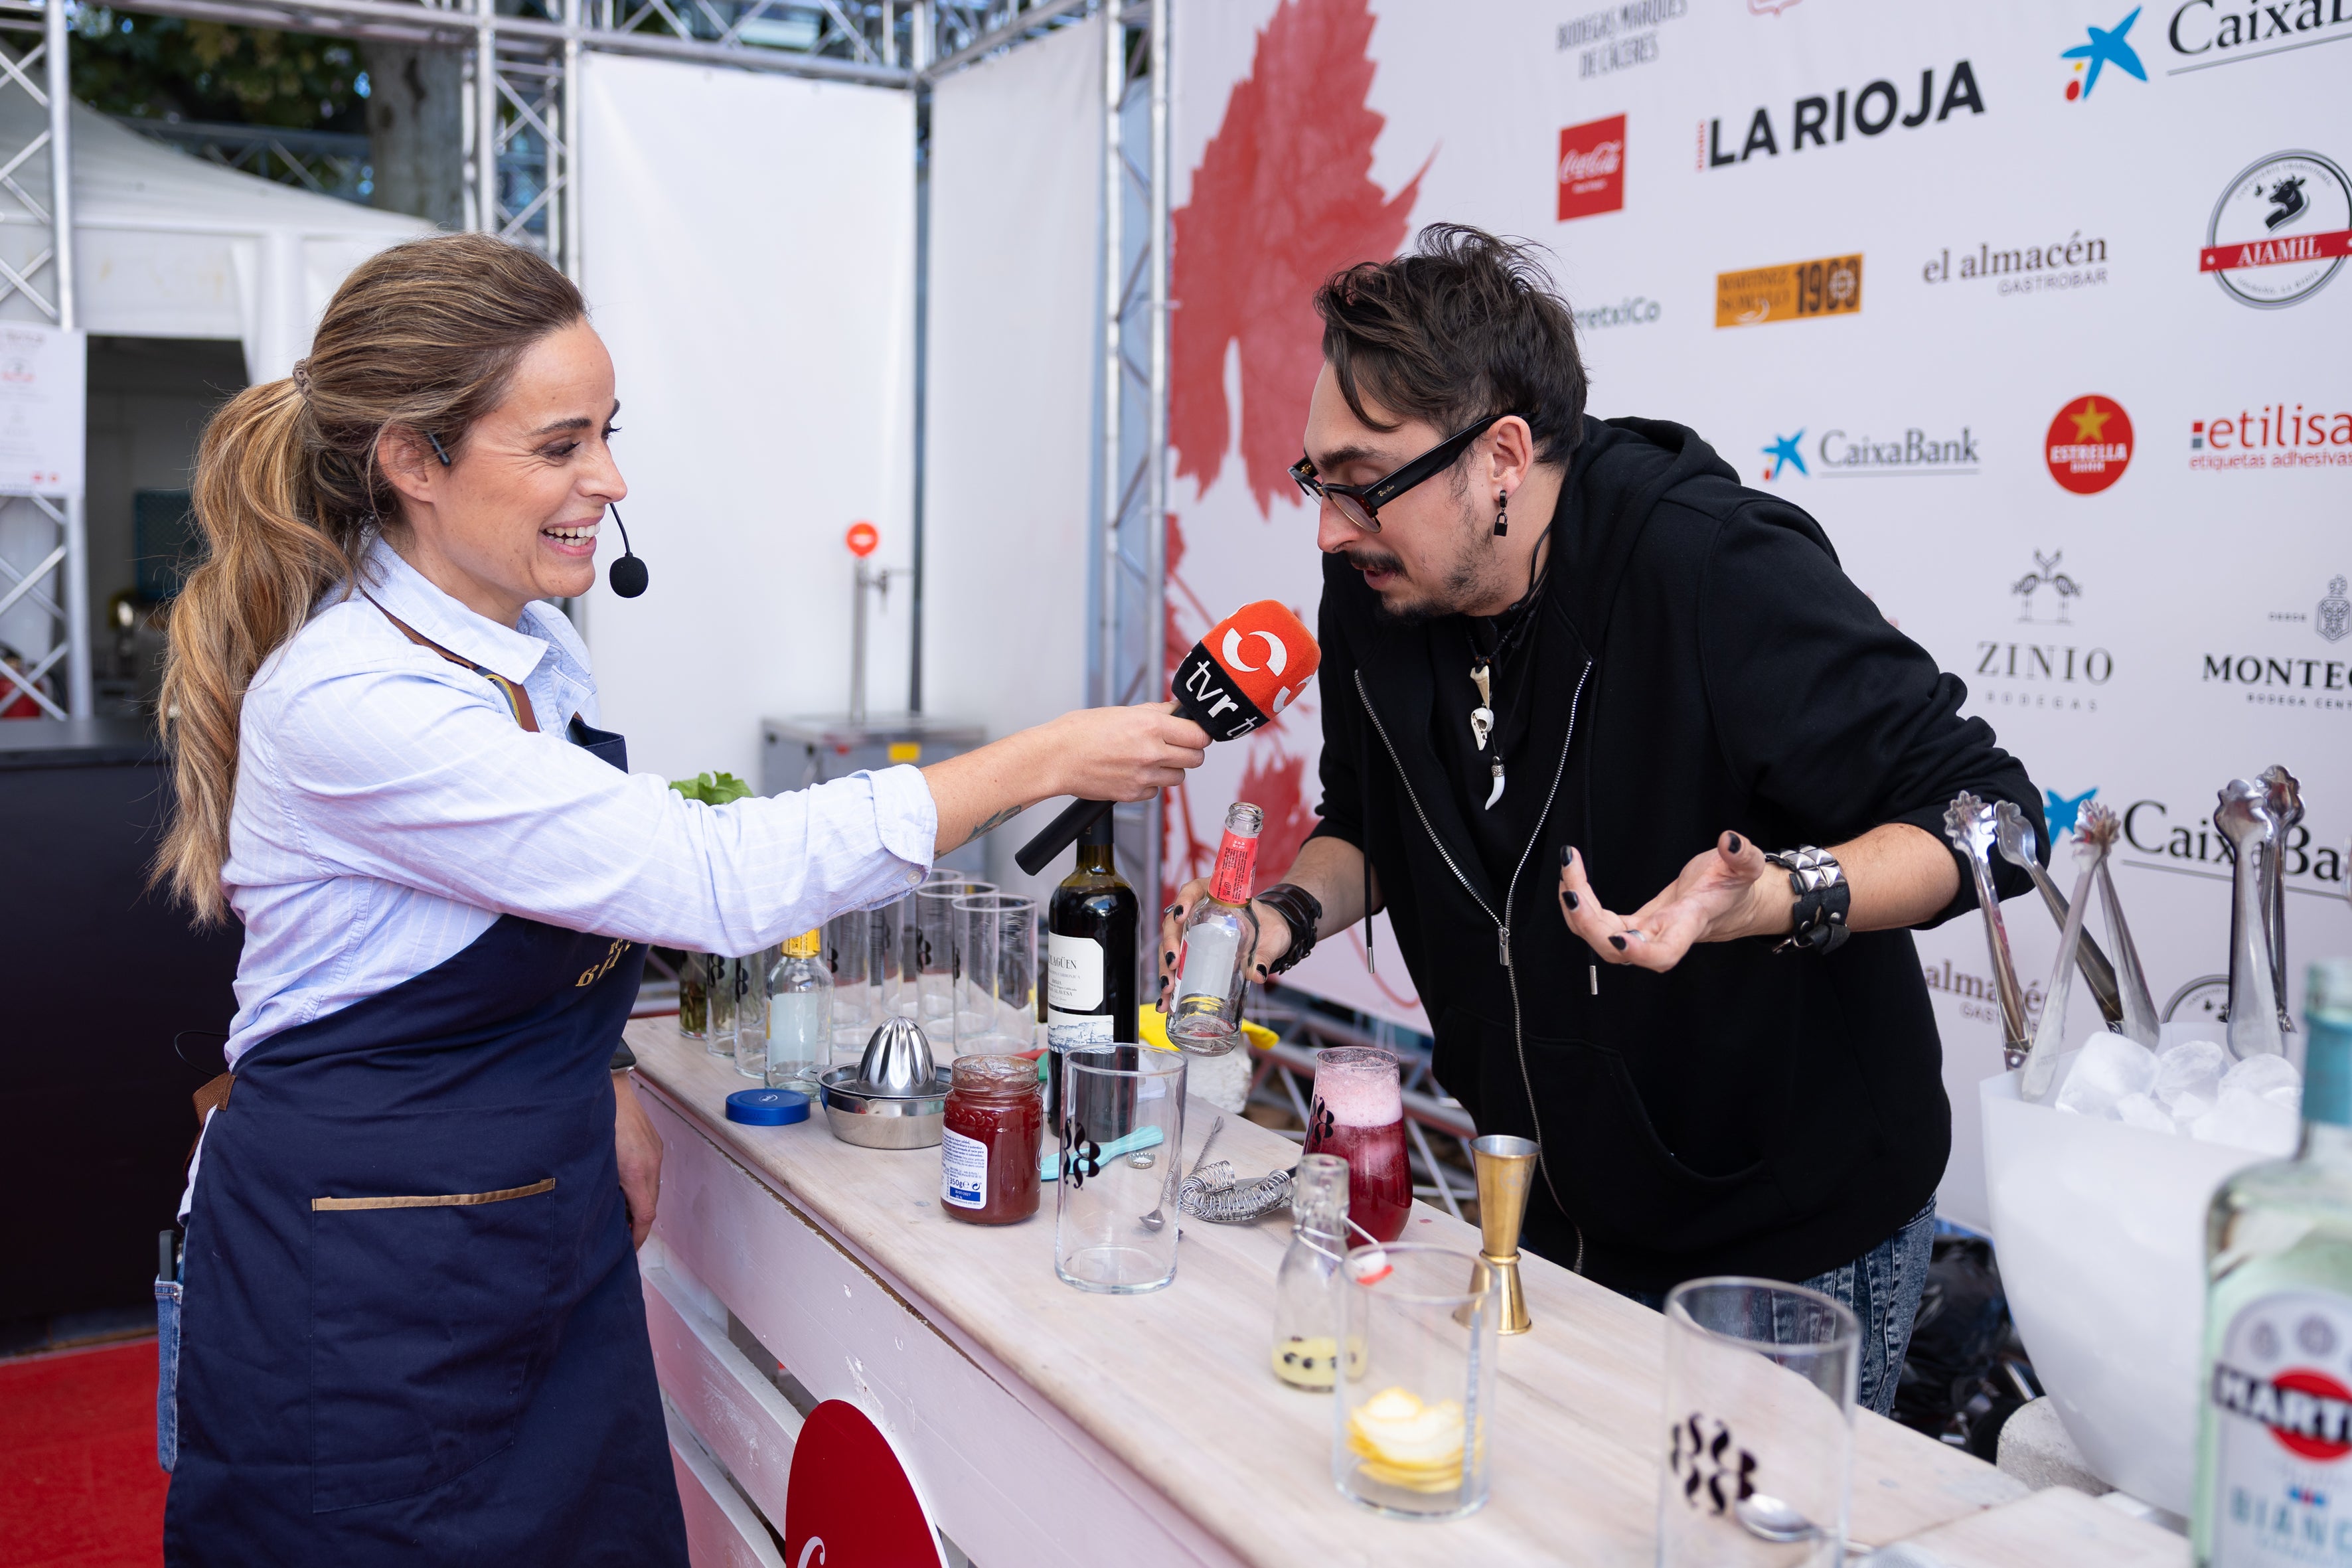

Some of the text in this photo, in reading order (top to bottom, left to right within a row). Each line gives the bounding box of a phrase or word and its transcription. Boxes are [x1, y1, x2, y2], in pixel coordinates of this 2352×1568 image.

[1710, 108, 1778, 168] LA
[1793, 60, 1986, 151] RIOJA
[1923, 228, 2108, 283] el almacén
[2236, 236, 2322, 267] AJAMIL
[1573, 297, 1661, 329] retxiCo
[2208, 403, 2352, 449] etilisa
[1819, 427, 1980, 468] CaixaBank
[2051, 443, 2128, 463] ESTRELLA
[2191, 453, 2266, 471] etiquetas
[1976, 641, 2114, 685] ZINIO
[2203, 653, 2352, 691] MONTE
[1186, 660, 1239, 718] tvr
[1227, 716, 1260, 740] tv
[1049, 954, 1077, 969] LAGÜEN
